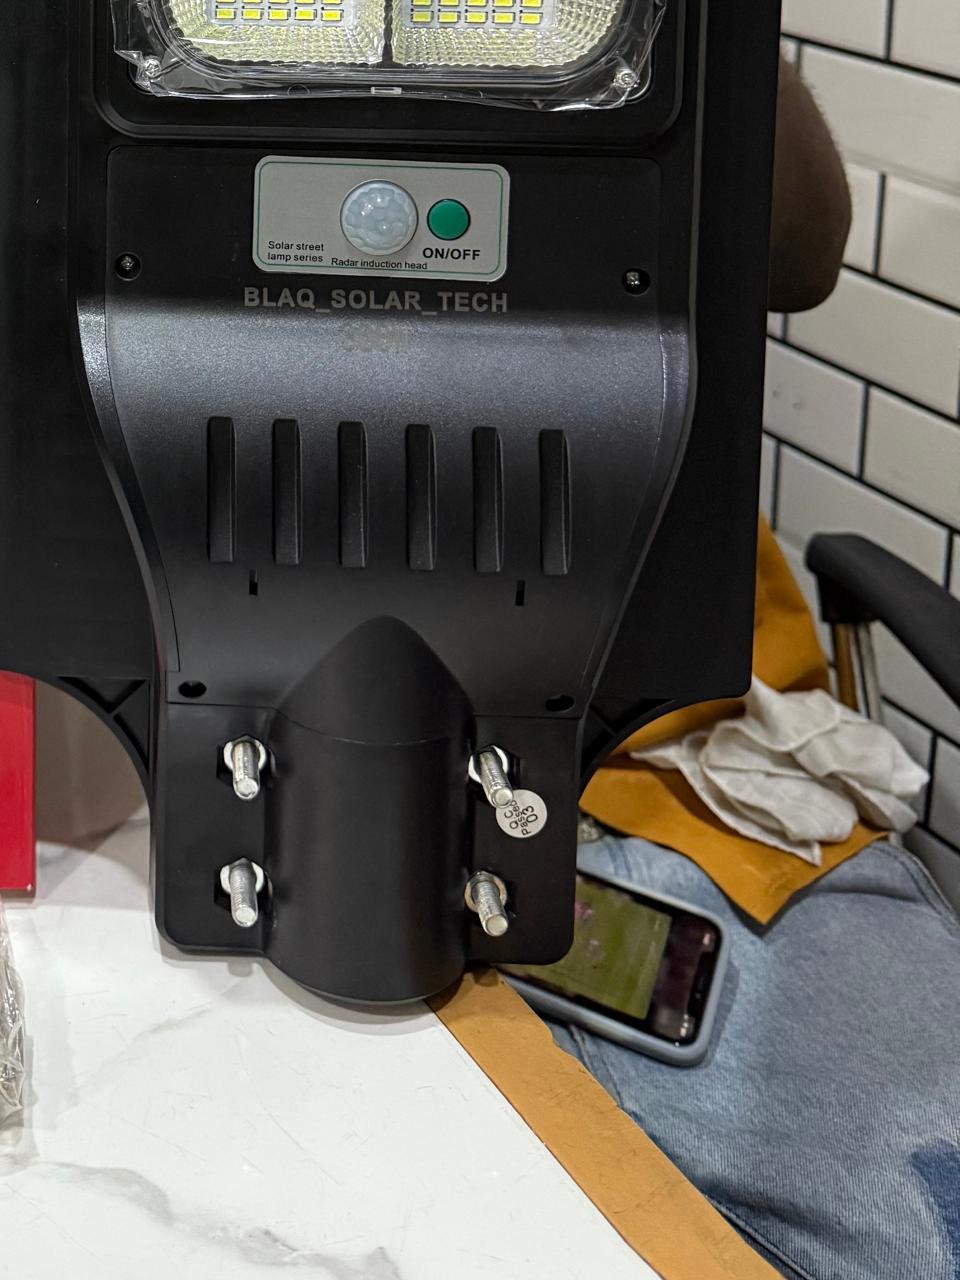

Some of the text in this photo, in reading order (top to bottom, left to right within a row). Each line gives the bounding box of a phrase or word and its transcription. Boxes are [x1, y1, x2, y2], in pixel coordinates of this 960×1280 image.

[268, 240, 324, 252] Solar street
[268, 252, 323, 263] lamp series
[422, 247, 481, 260] ON/OFF
[331, 257, 427, 270] Radar induction head
[244, 287, 508, 315] BLAQ_SOLAR_TECH
[522, 805, 538, 823] 03
